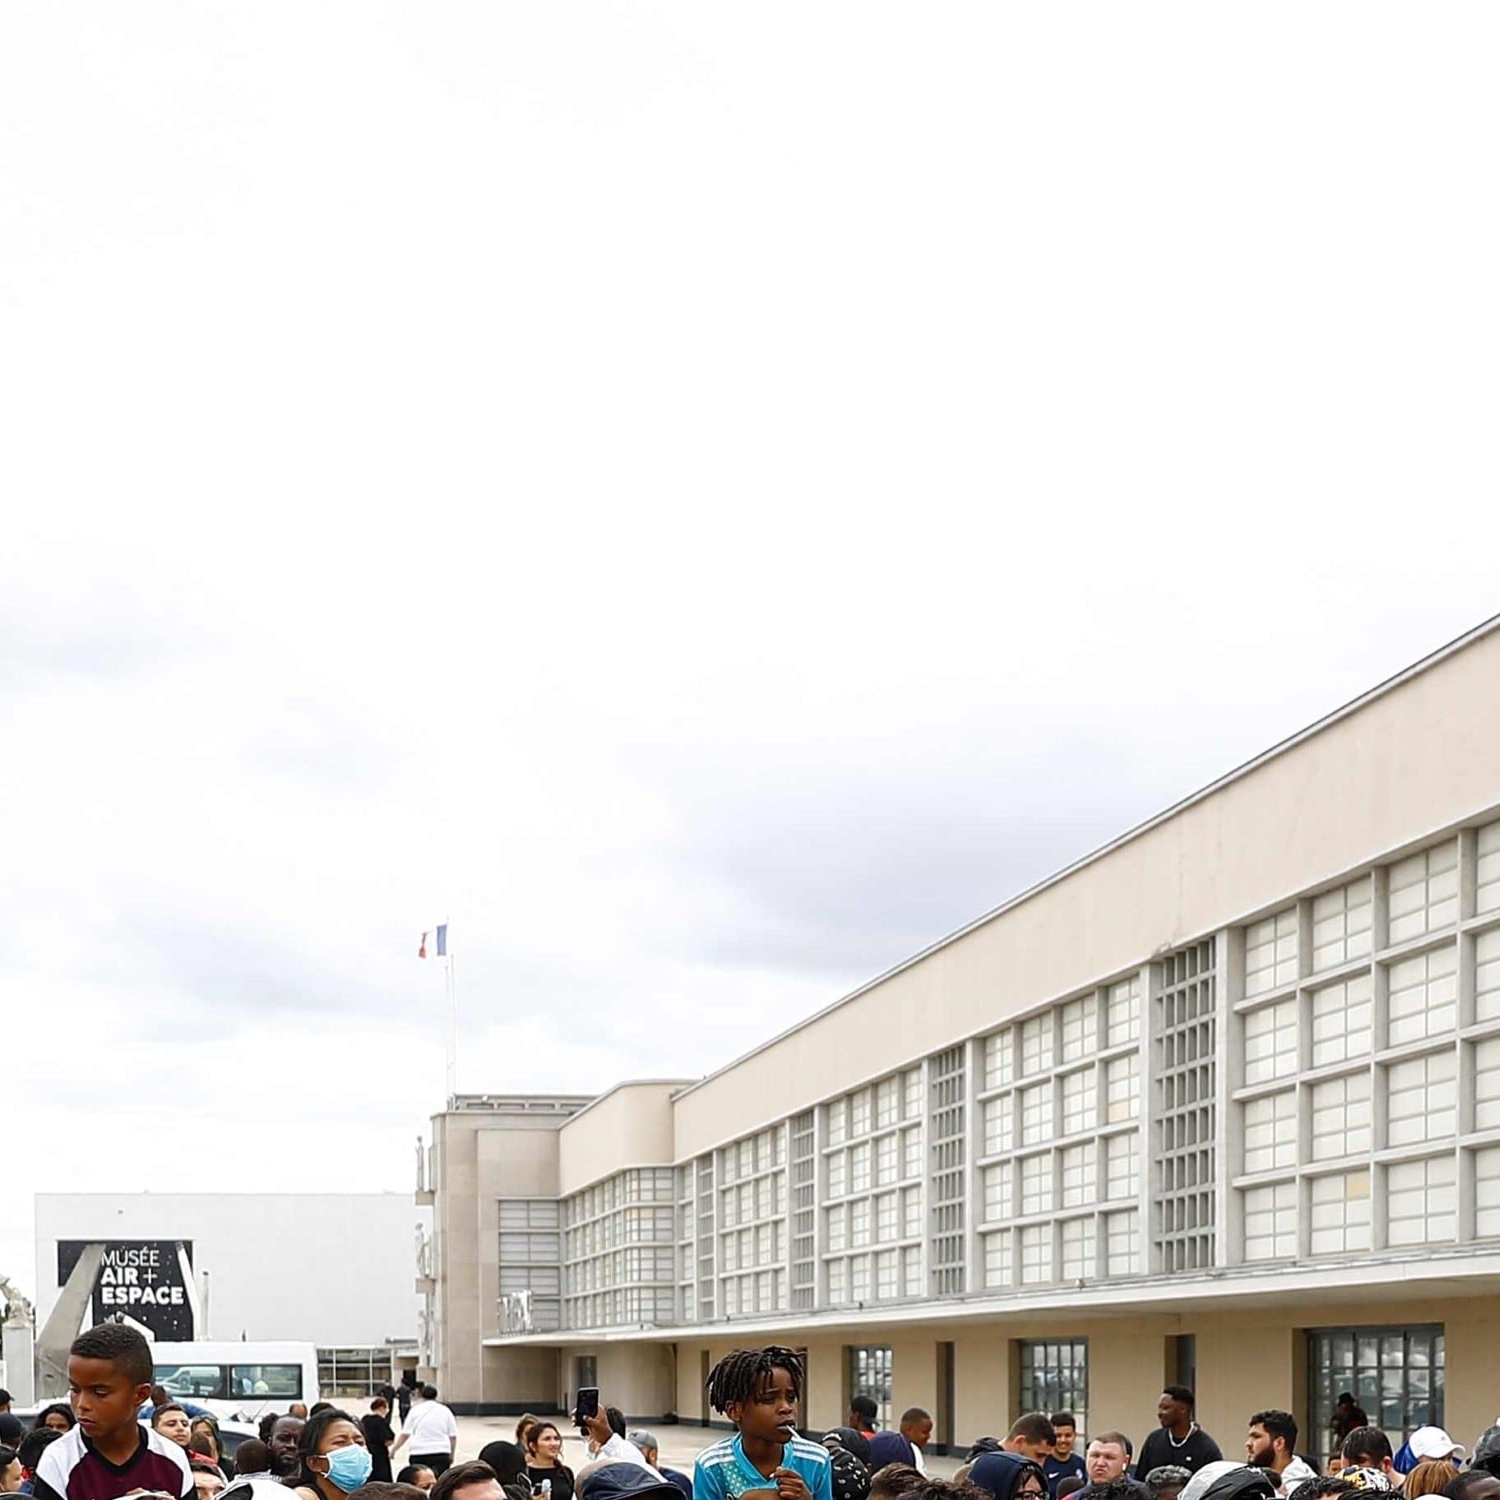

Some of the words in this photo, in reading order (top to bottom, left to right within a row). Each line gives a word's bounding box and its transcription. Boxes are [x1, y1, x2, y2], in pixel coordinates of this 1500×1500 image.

[101, 1246, 160, 1266] MUSÉE
[100, 1267, 139, 1285] AIR
[101, 1286, 184, 1305] ESPACE
